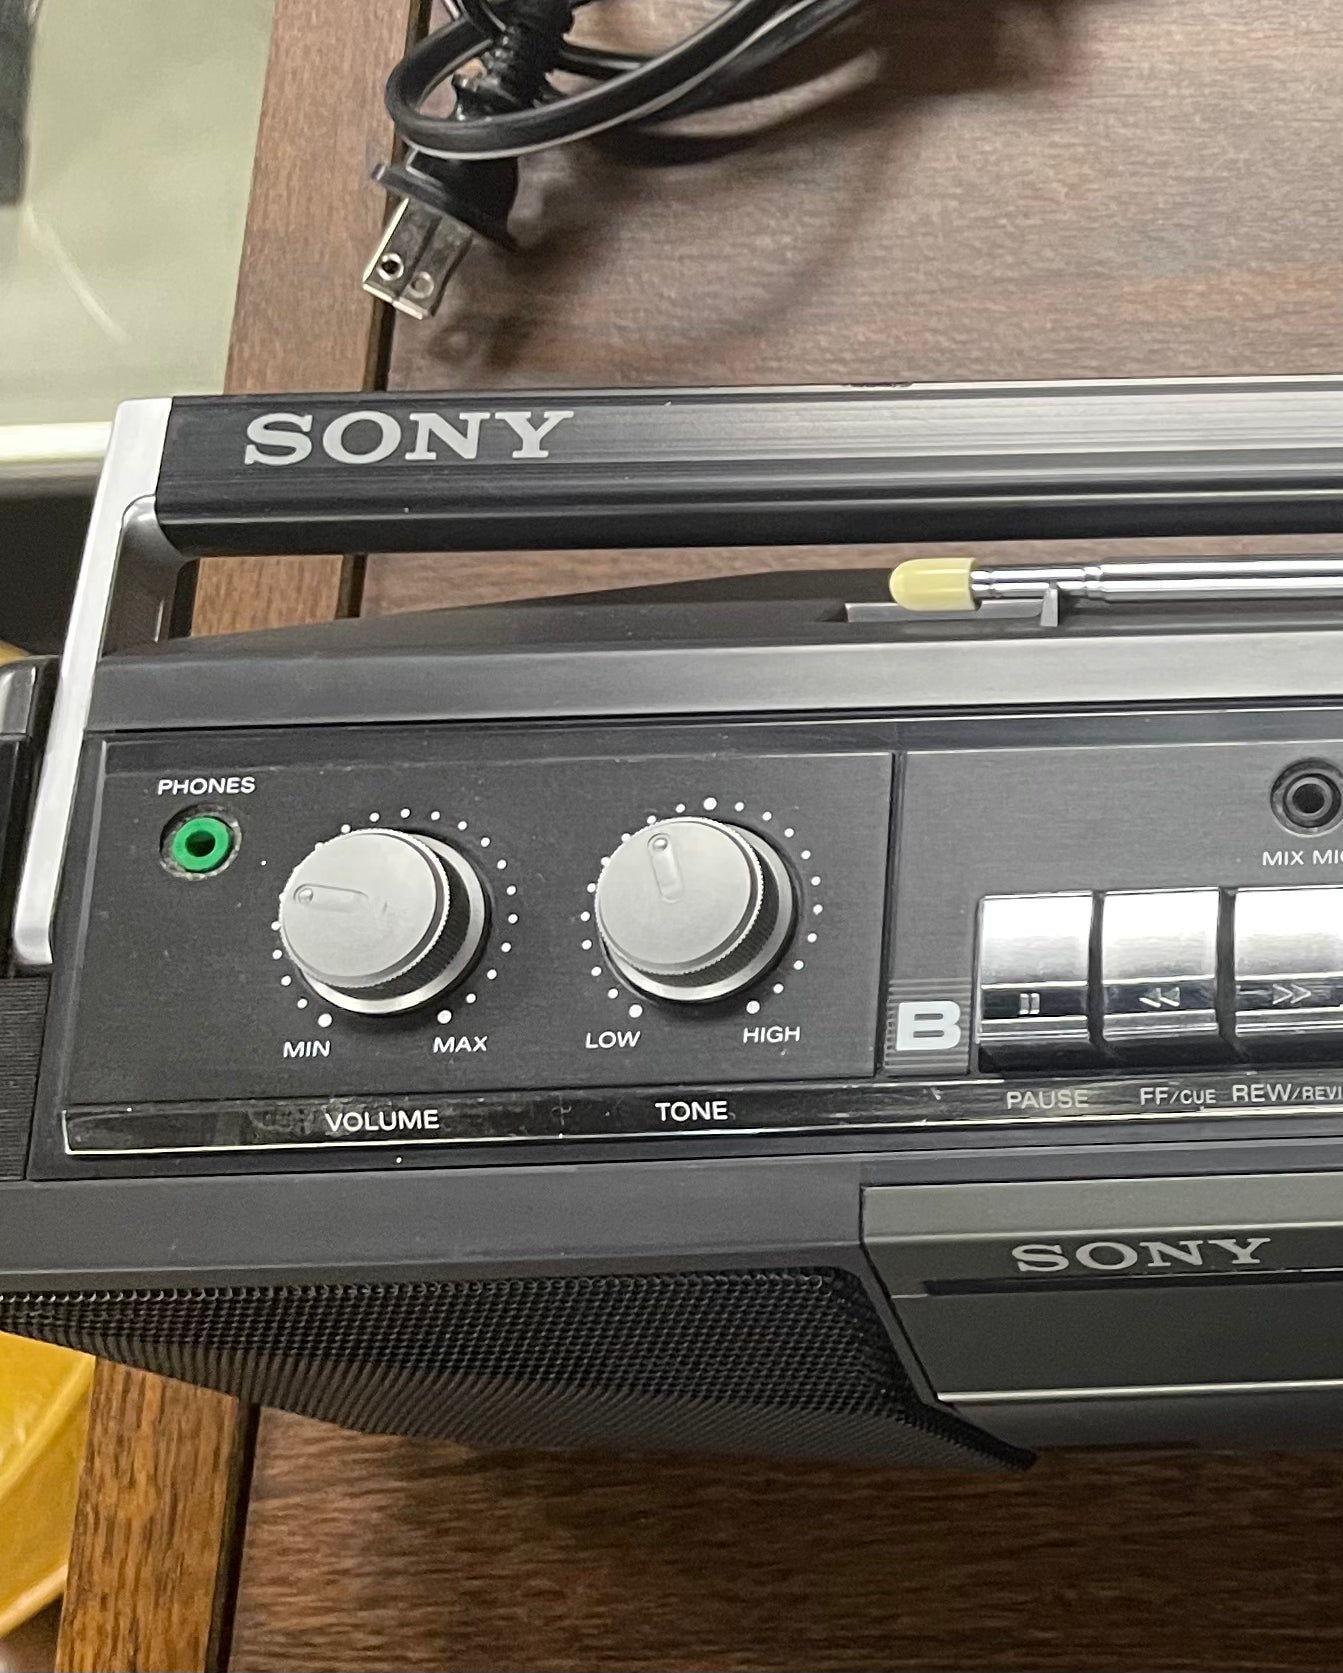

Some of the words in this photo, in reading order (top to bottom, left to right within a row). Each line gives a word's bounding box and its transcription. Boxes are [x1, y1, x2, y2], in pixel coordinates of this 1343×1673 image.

[243, 410, 575, 466] SONY
[157, 776, 256, 797] PHONES
[1261, 848, 1305, 867] MIX
[742, 1025, 802, 1046] HIGH
[895, 1000, 963, 1053] B
[282, 1039, 332, 1060] MIN
[433, 1034, 488, 1055] MAX
[585, 1029, 642, 1050] LOW
[1006, 1089, 1091, 1111] PAUSE
[1139, 1086, 1218, 1106] FF/CUE
[324, 1108, 440, 1134] VOLUME
[655, 1100, 730, 1124] TONE
[1009, 1236, 1273, 1273] SONY
